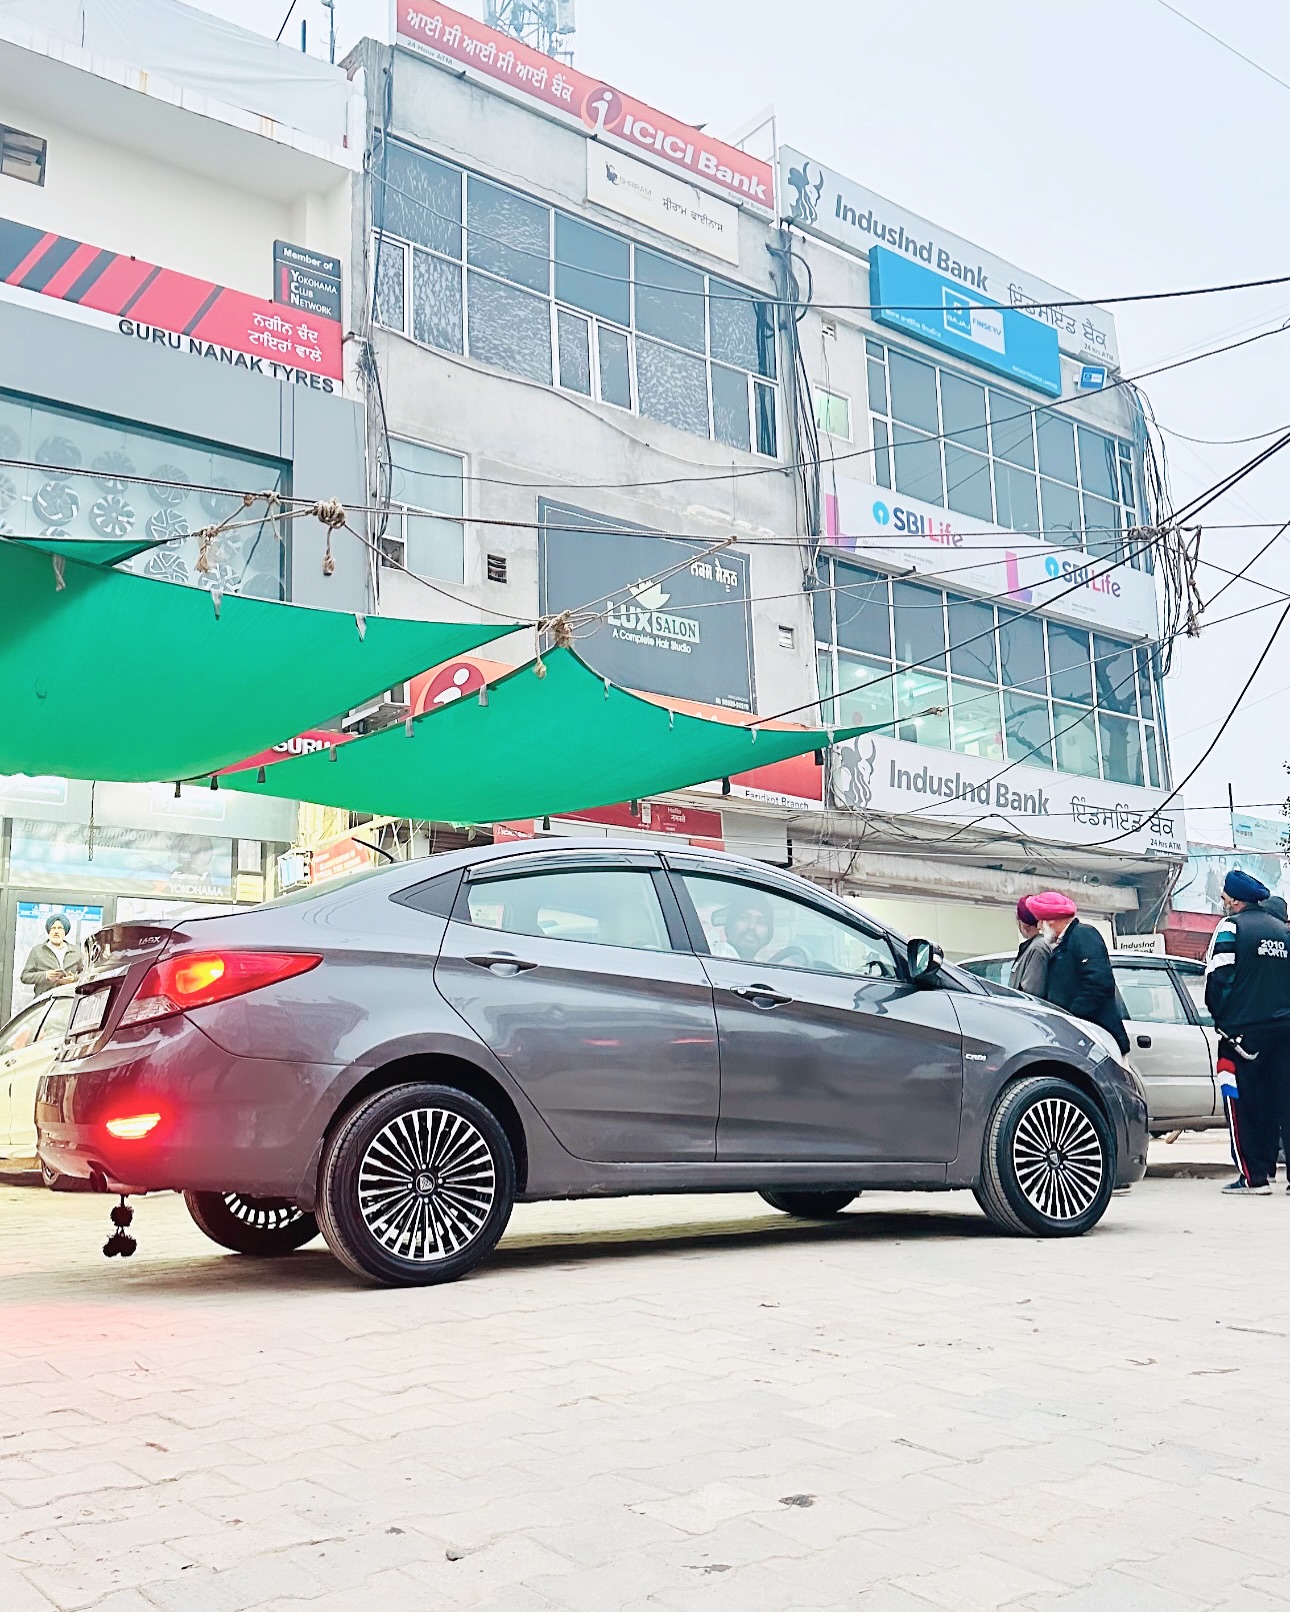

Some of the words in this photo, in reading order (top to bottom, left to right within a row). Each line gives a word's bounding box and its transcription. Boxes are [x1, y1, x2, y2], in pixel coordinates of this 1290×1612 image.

[407, 40, 416, 48] 24
[436, 53, 453, 65] ATM
[407, 9, 442, 39] ਆਈ
[443, 26, 462, 48] ਸੀ
[463, 35, 495, 64] ਆਈ
[497, 51, 514, 73] ਸੀ
[516, 60, 548, 90] ਆਈ
[551, 73, 574, 102] ਬੈਂਕ
[623, 115, 694, 165] ICICI
[698, 151, 767, 200] Bank
[619, 176, 652, 197] SHRIRAM
[835, 194, 934, 264] IndusInd
[936, 247, 989, 292] Bank
[283, 248, 321, 267] Member
[322, 261, 334, 271] of
[290, 269, 337, 295] YOKOHAMA
[290, 282, 314, 299] CLUB
[290, 293, 332, 316] NETWORK
[252, 312, 293, 336] ਨਗੀਨ
[295, 323, 319, 344] ਚੰਦ
[947, 314, 970, 330] BAJAJ
[972, 318, 1002, 336] FINSERV
[118, 319, 181, 350] GURU
[189, 338, 263, 374] NANAK
[269, 361, 334, 394] TYRES
[247, 330, 292, 353] ਟਾਇਰਾਂ
[294, 345, 323, 363] ਵਾਲੇ
[893, 507, 925, 539] SBI
[928, 517, 963, 547] Life
[1062, 561, 1090, 588] SBI
[1091, 570, 1121, 598] Life
[607, 600, 652, 633] LUX
[654, 615, 697, 639] SALON
[612, 630, 619, 638] A
[619, 630, 655, 647] Complete
[655, 637, 670, 649] Hair
[670, 640, 692, 654] Studio
[745, 789, 779, 805] Faridkot
[781, 796, 809, 810] Branch
[889, 759, 992, 806] IndusInd
[996, 782, 1050, 817] Bank
[1150, 838, 1158, 847] 24
[1158, 840, 1168, 848] hrs
[1168, 842, 1181, 851] ATM
[169, 883, 224, 897] YOKOHAMA
[1120, 940, 1156, 950] IndusInd
[1260, 939, 1285, 950] 2010
